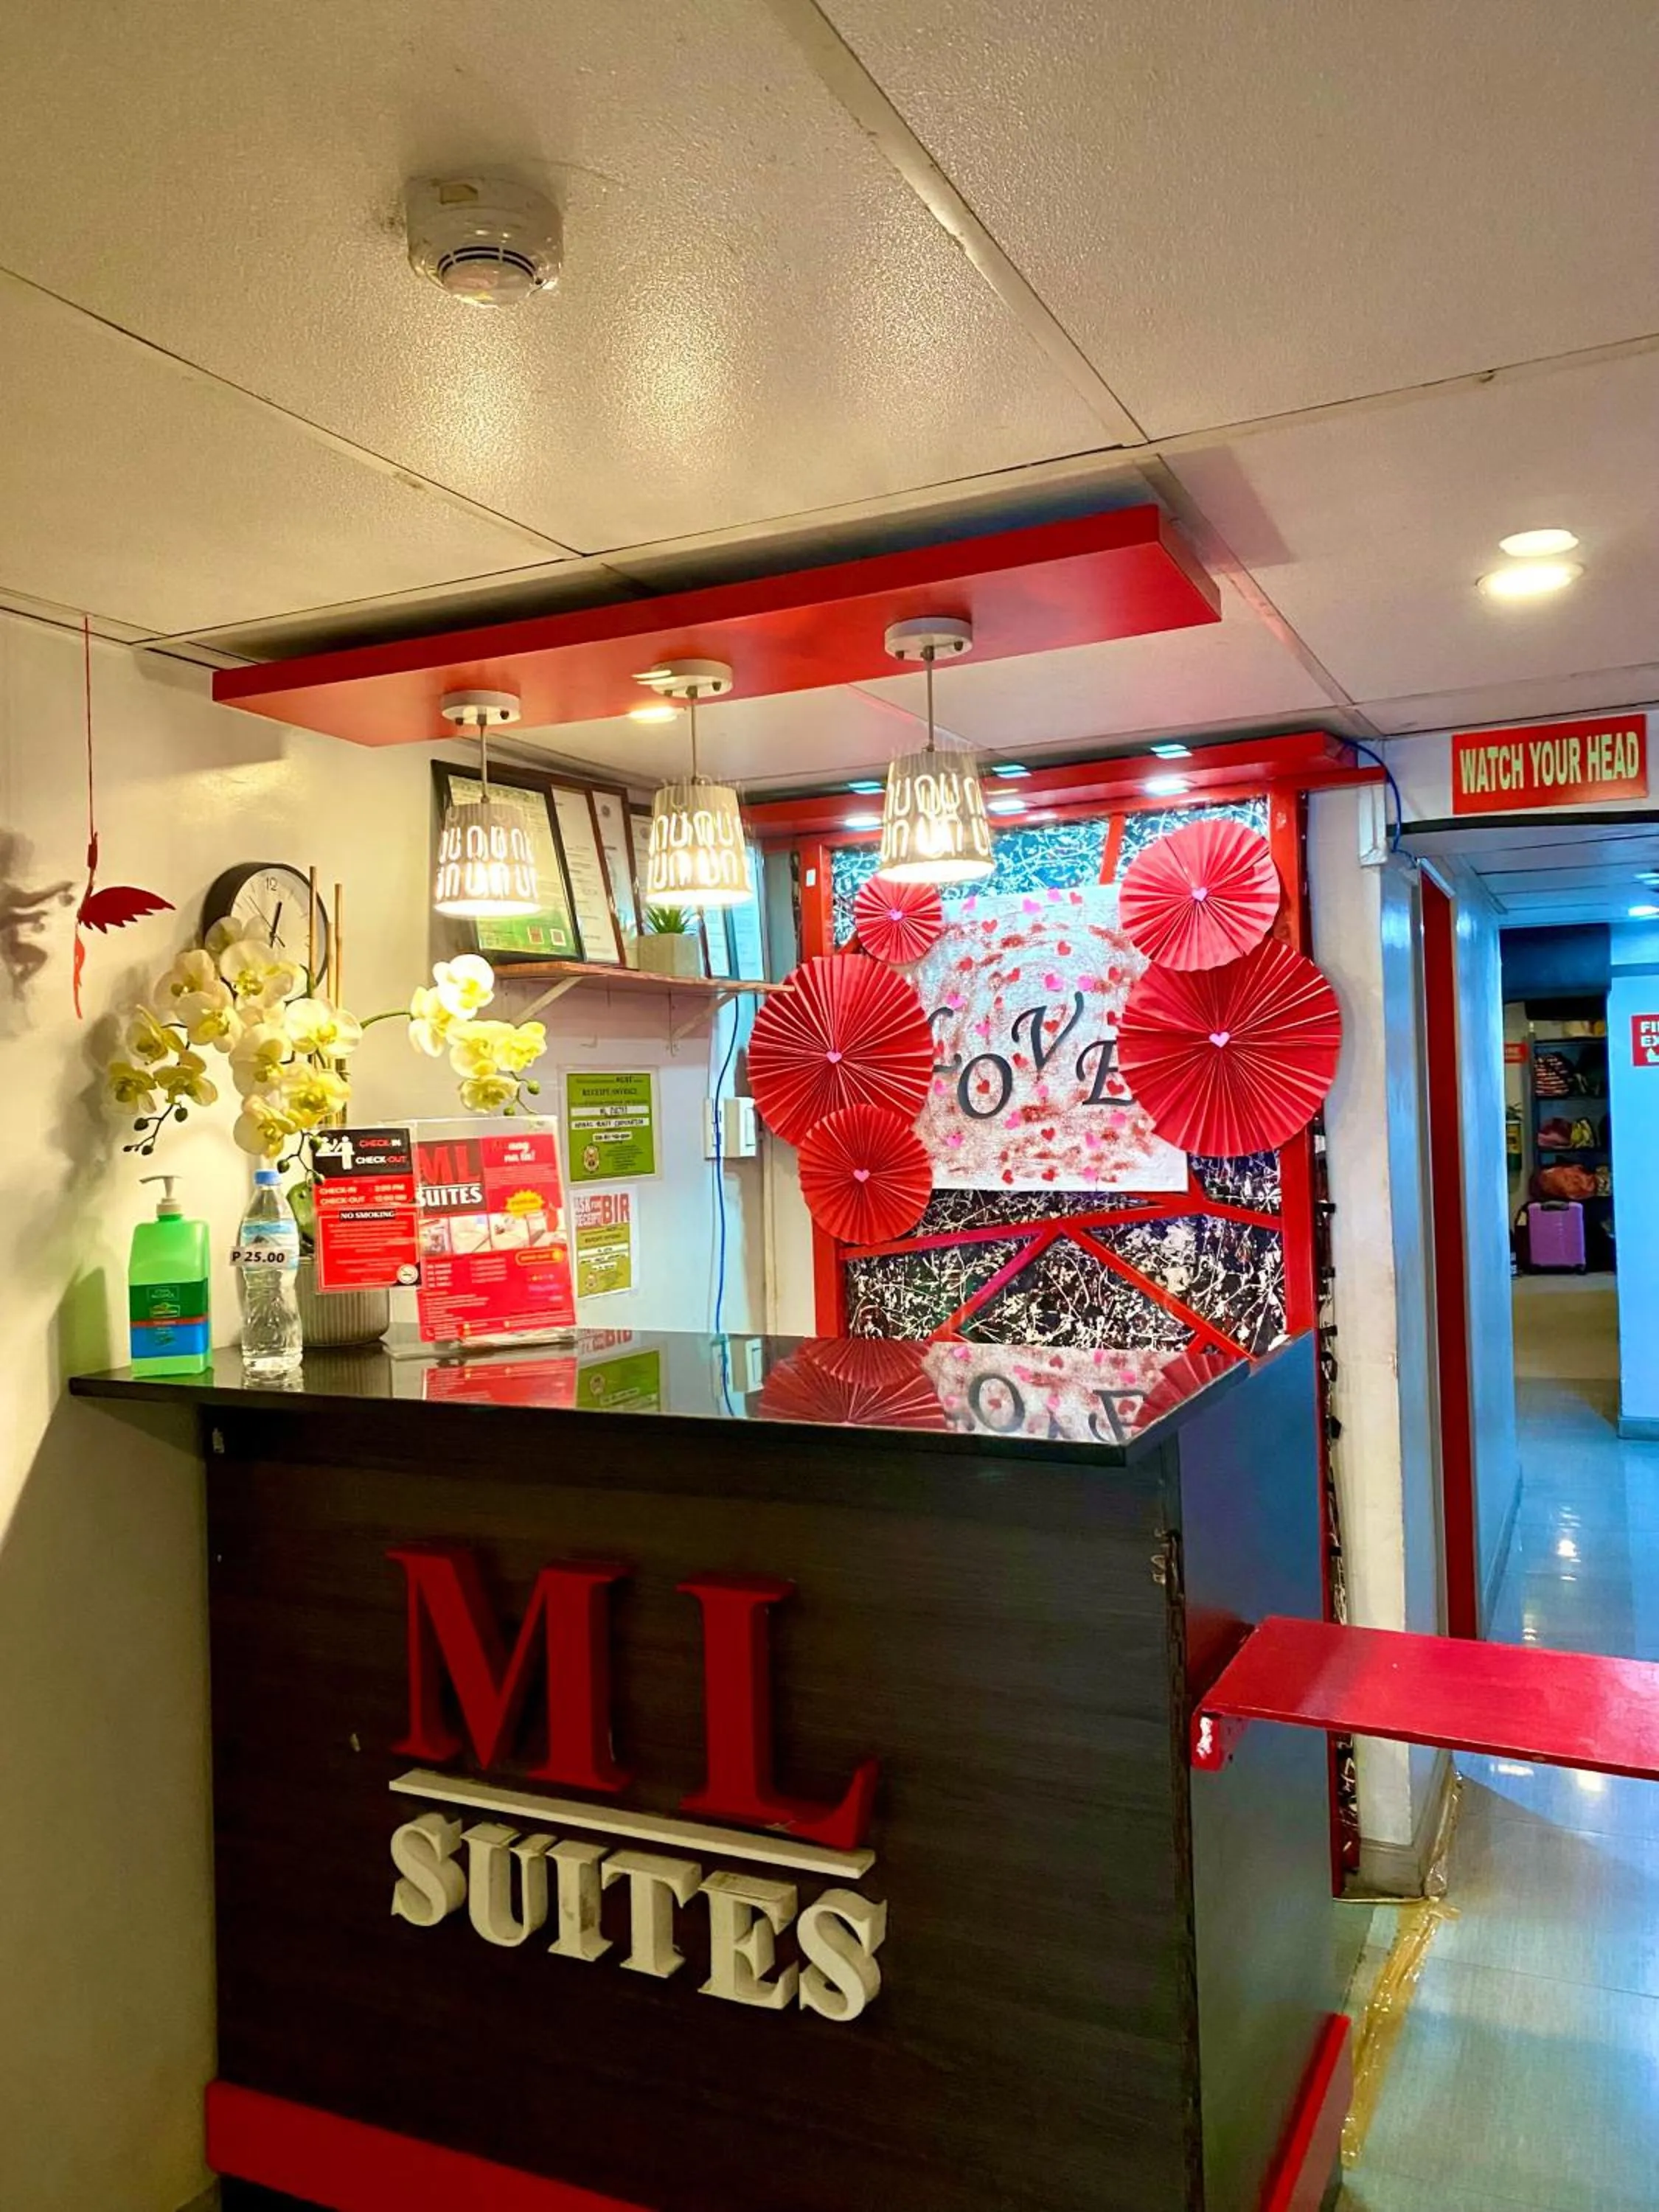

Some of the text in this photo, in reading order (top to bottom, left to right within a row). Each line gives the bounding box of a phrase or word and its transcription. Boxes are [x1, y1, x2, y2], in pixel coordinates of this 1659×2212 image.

[1460, 731, 1639, 794] WATCH YOUR HEAD
[266, 877, 277, 891] 12
[417, 1145, 481, 1185] ML
[416, 1186, 483, 1207] SUITES
[602, 1193, 630, 1224] BIR
[355, 1211, 395, 1219] SMOKING
[232, 1251, 285, 1263] P 25.00
[386, 1545, 879, 1851] ML
[390, 1812, 888, 2022] SUITES
